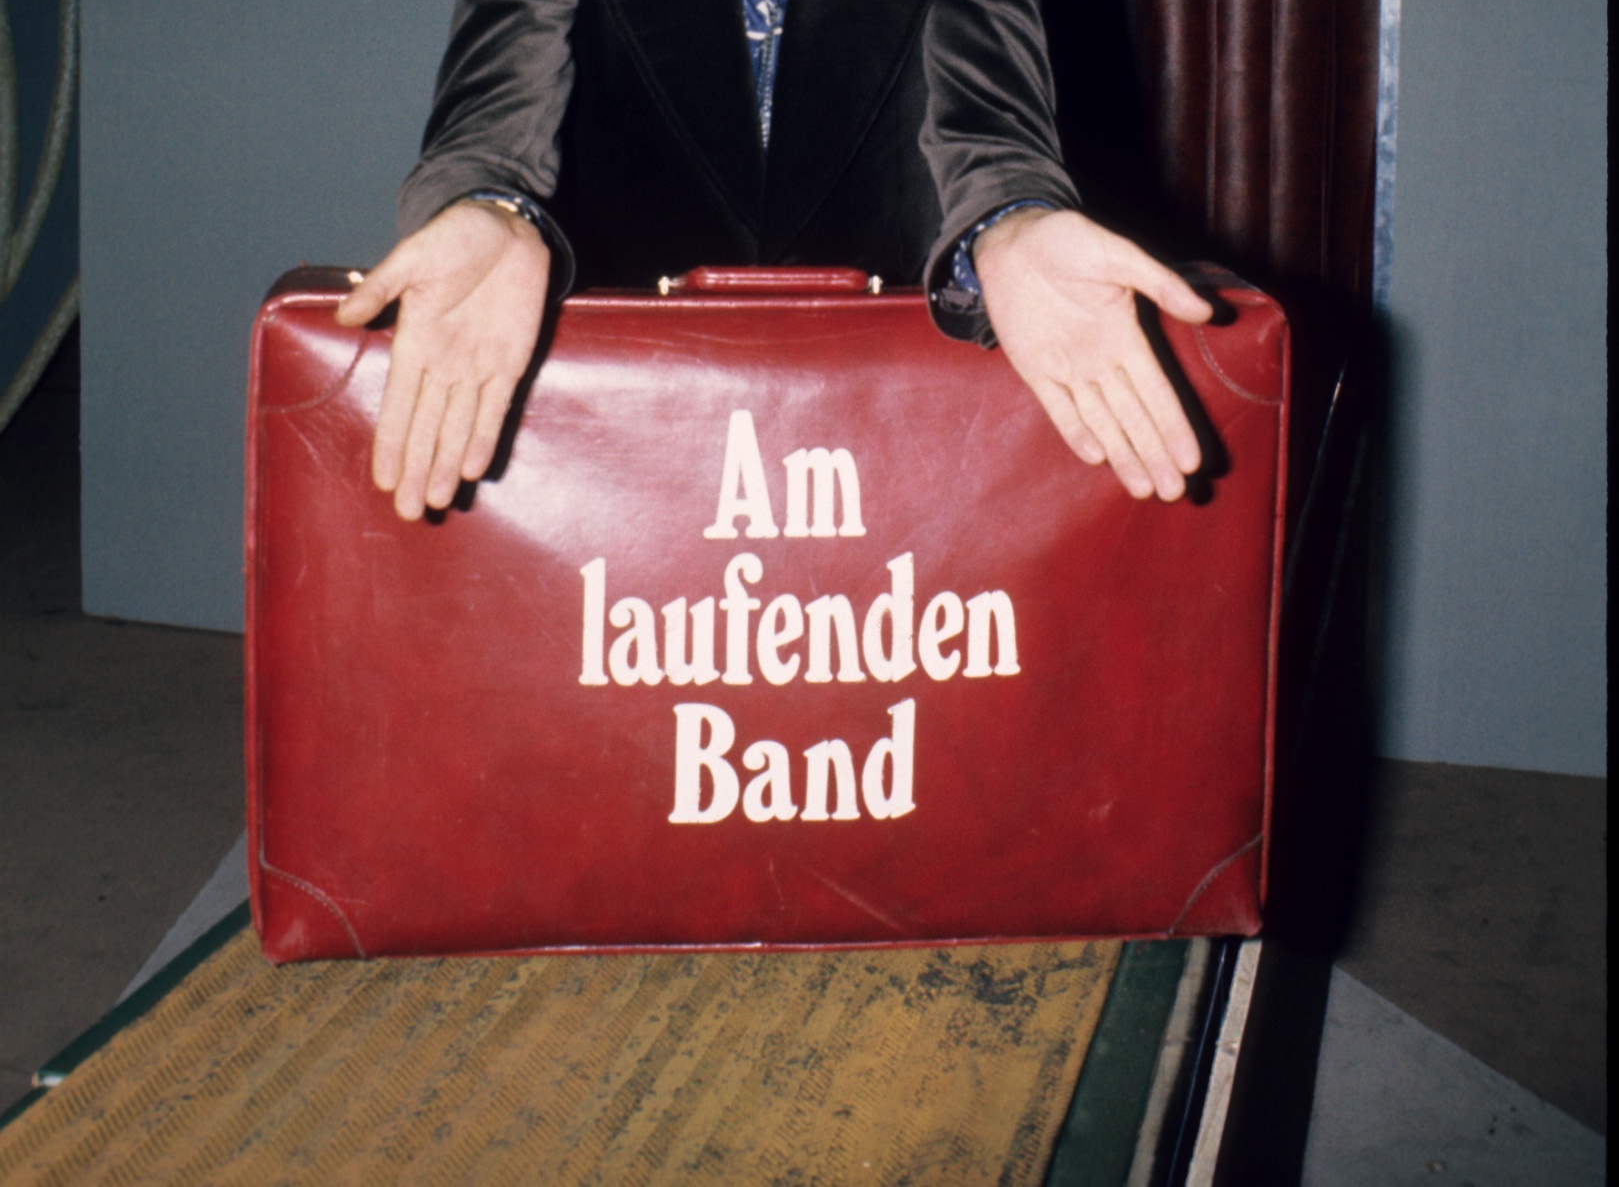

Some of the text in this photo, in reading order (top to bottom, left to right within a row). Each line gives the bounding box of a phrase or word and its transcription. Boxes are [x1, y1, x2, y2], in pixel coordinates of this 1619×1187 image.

[703, 408, 866, 540] Am
[578, 551, 1022, 688] laufenden
[667, 697, 918, 825] Band
